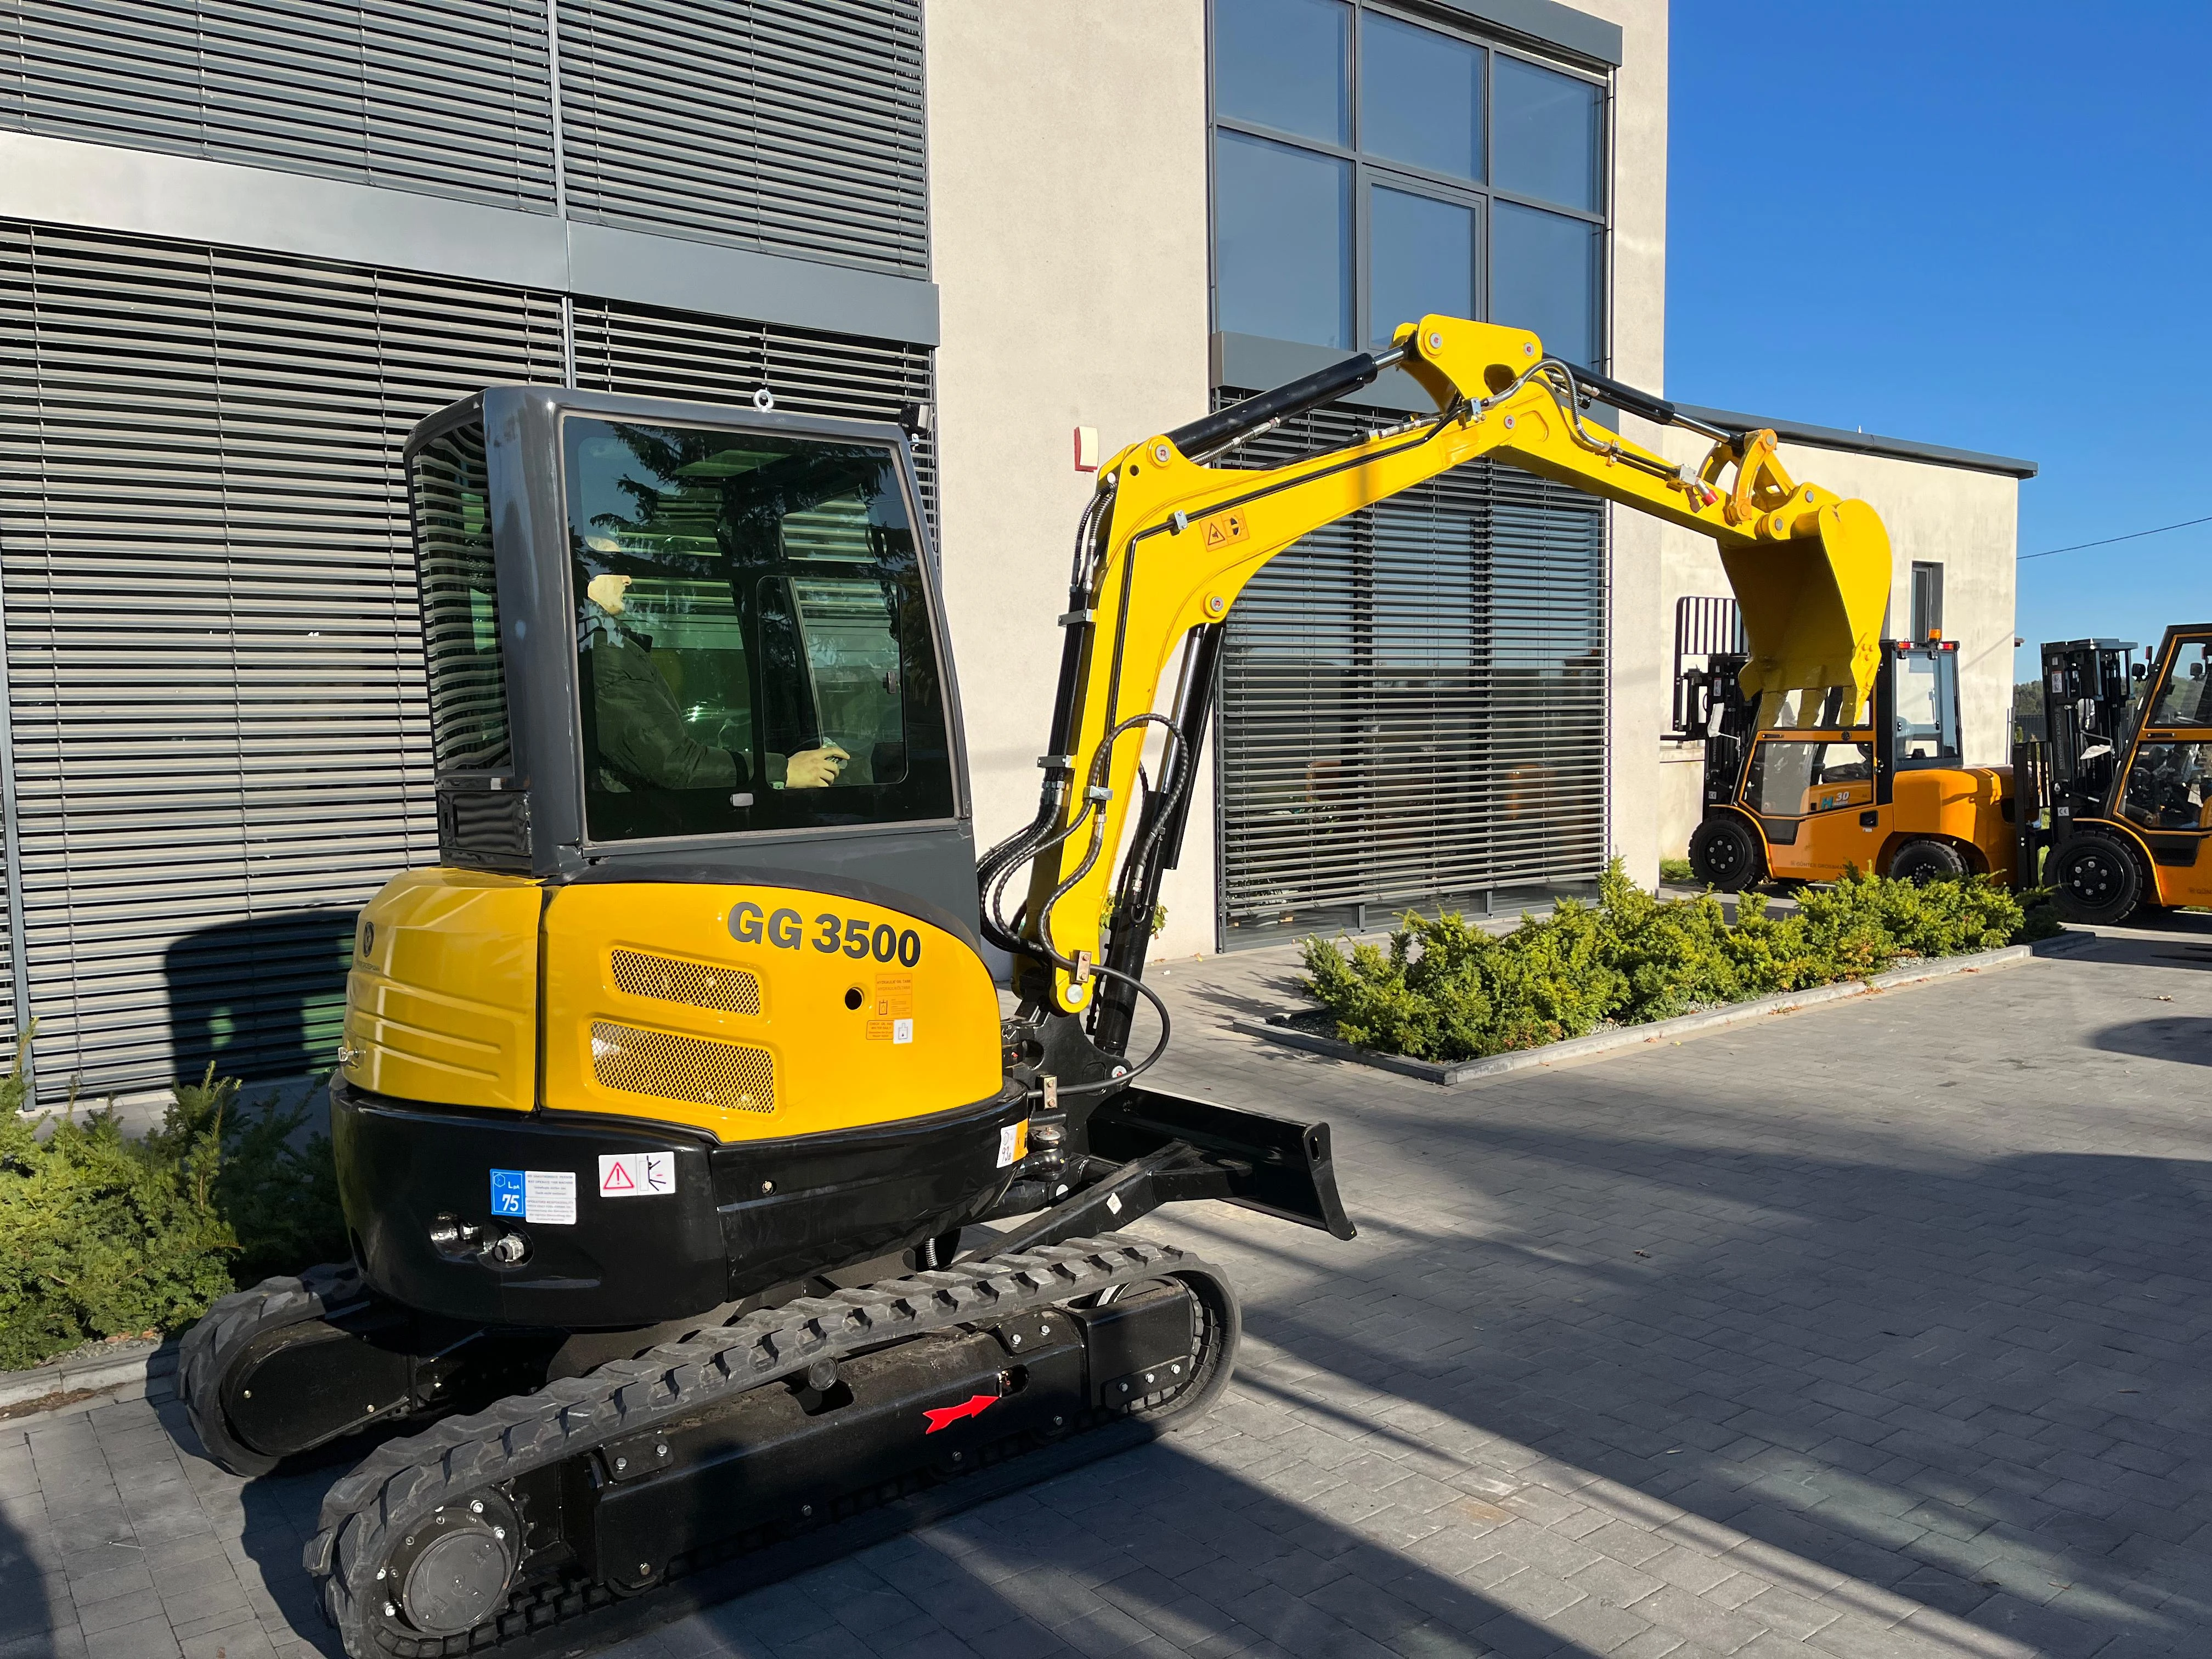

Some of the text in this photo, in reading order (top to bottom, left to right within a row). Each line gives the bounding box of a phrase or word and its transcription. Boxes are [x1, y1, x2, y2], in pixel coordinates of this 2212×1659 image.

[1836, 791, 1849, 802] 30
[727, 901, 921, 967] GG 3500
[502, 1193, 520, 1212] 75
